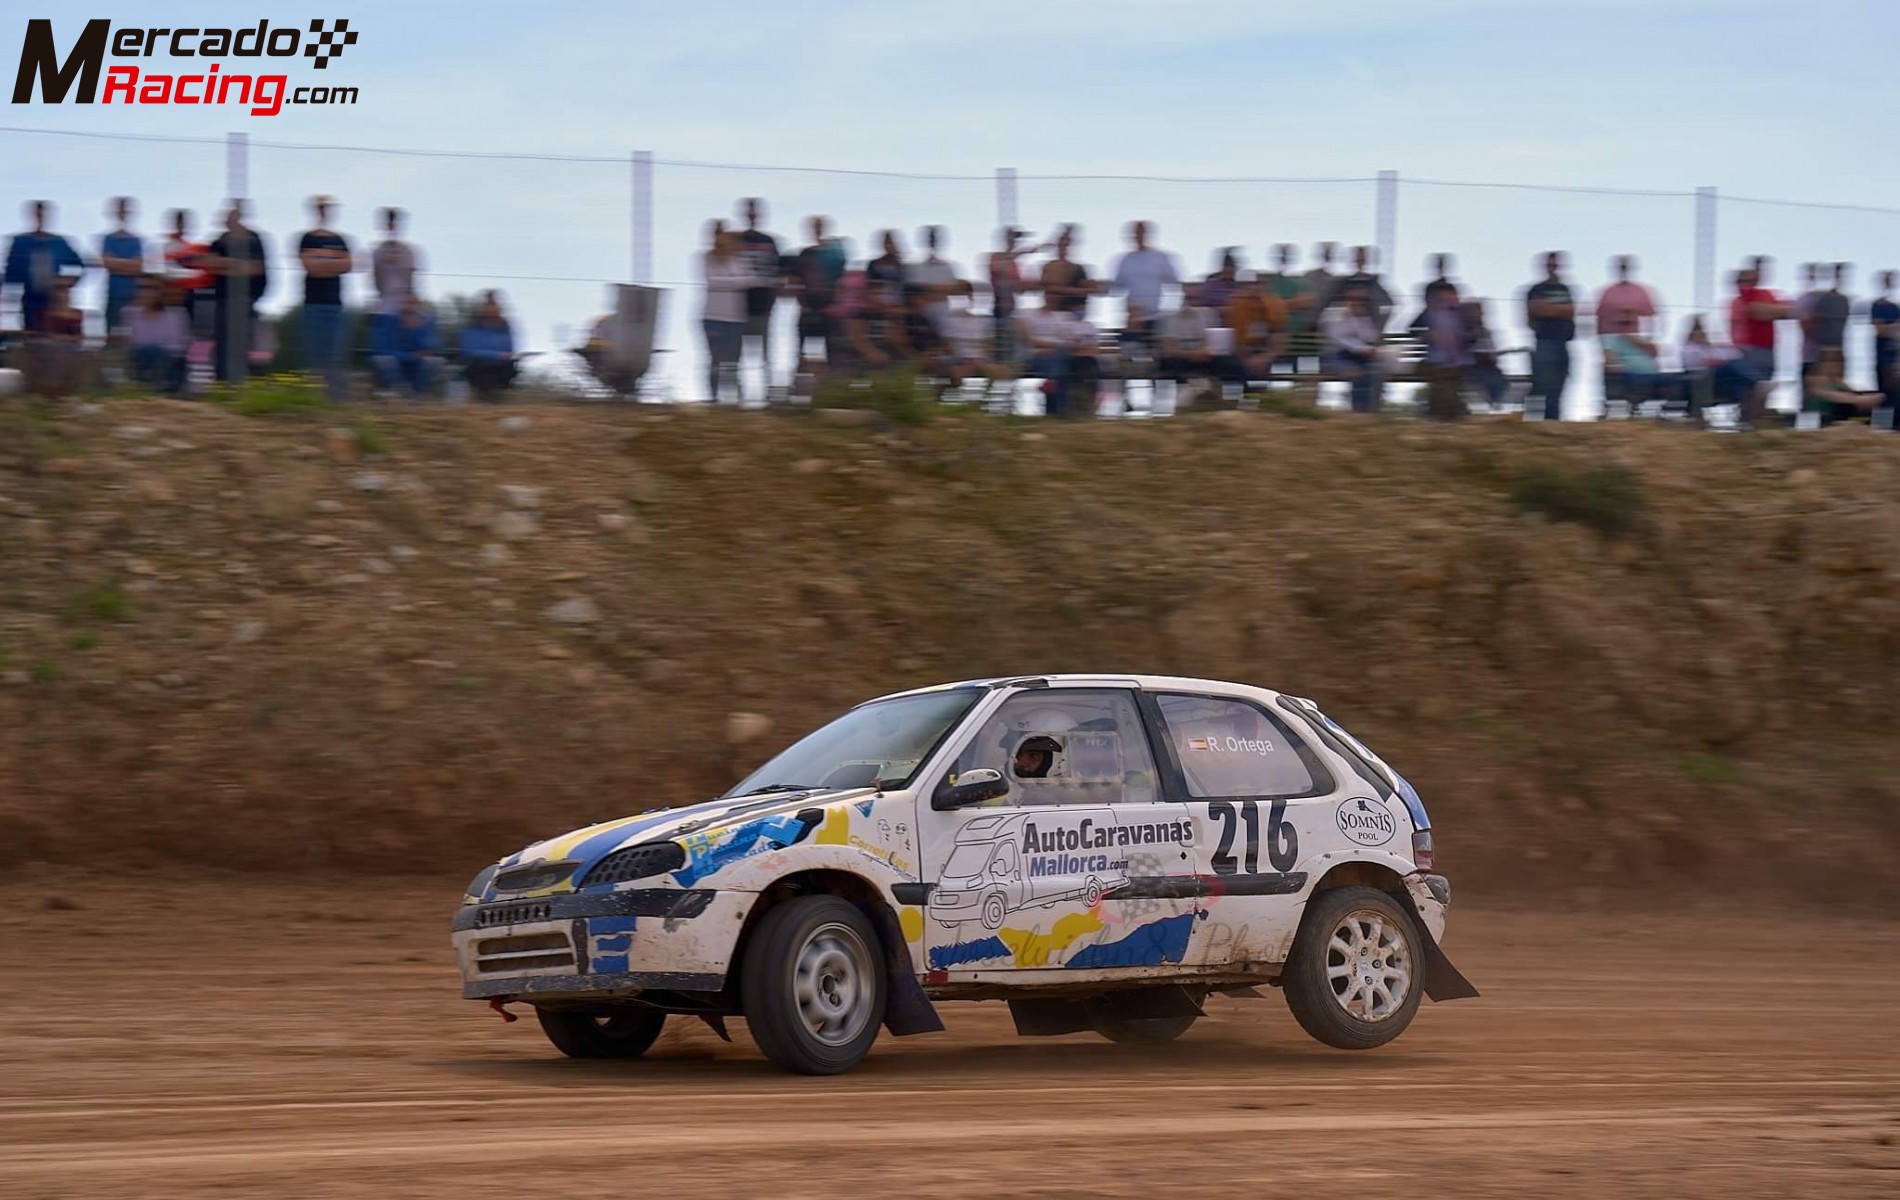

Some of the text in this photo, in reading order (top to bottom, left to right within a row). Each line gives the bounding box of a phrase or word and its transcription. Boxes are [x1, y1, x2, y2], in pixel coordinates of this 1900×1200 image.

[1207, 736, 1274, 756] R. Ortega
[1021, 818, 1194, 854] AutoCaravanas
[1208, 800, 1299, 875] 216
[1358, 832, 1379, 841] POOL
[1029, 853, 1129, 877] Mallorca.com
